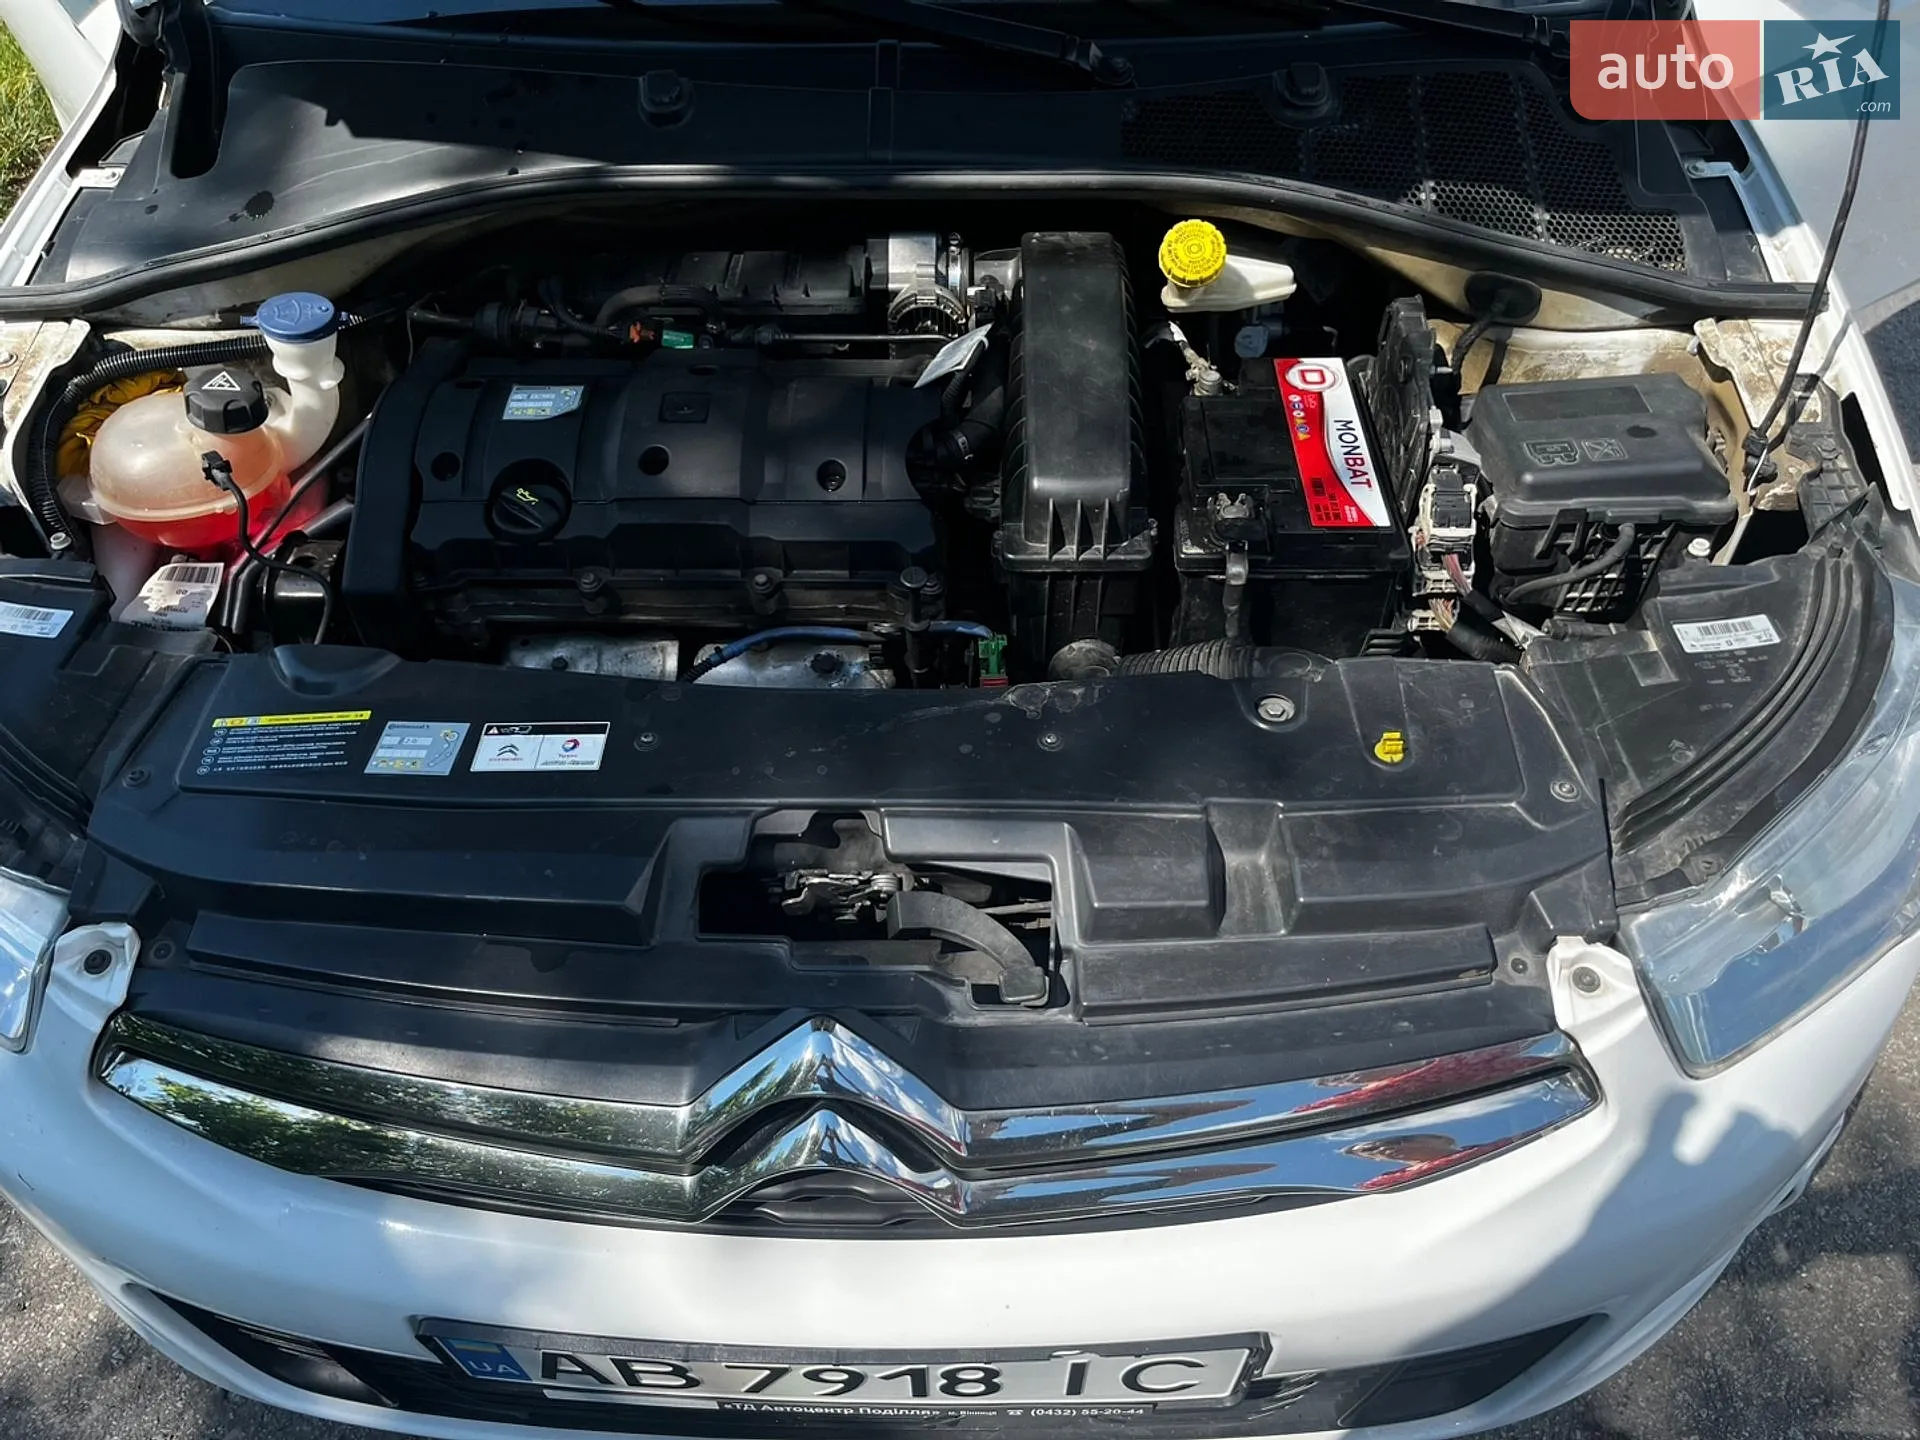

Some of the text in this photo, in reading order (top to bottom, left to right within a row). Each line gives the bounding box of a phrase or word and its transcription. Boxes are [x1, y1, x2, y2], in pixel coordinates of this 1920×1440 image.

[1333, 419, 1373, 489] MONBAT
[467, 1360, 521, 1377] UA
[540, 1351, 702, 1389] AB
[724, 1362, 1003, 1398] 7918
[760, 1404, 855, 1415] Автоцентр
[1030, 1408, 1077, 1417] (0432)
